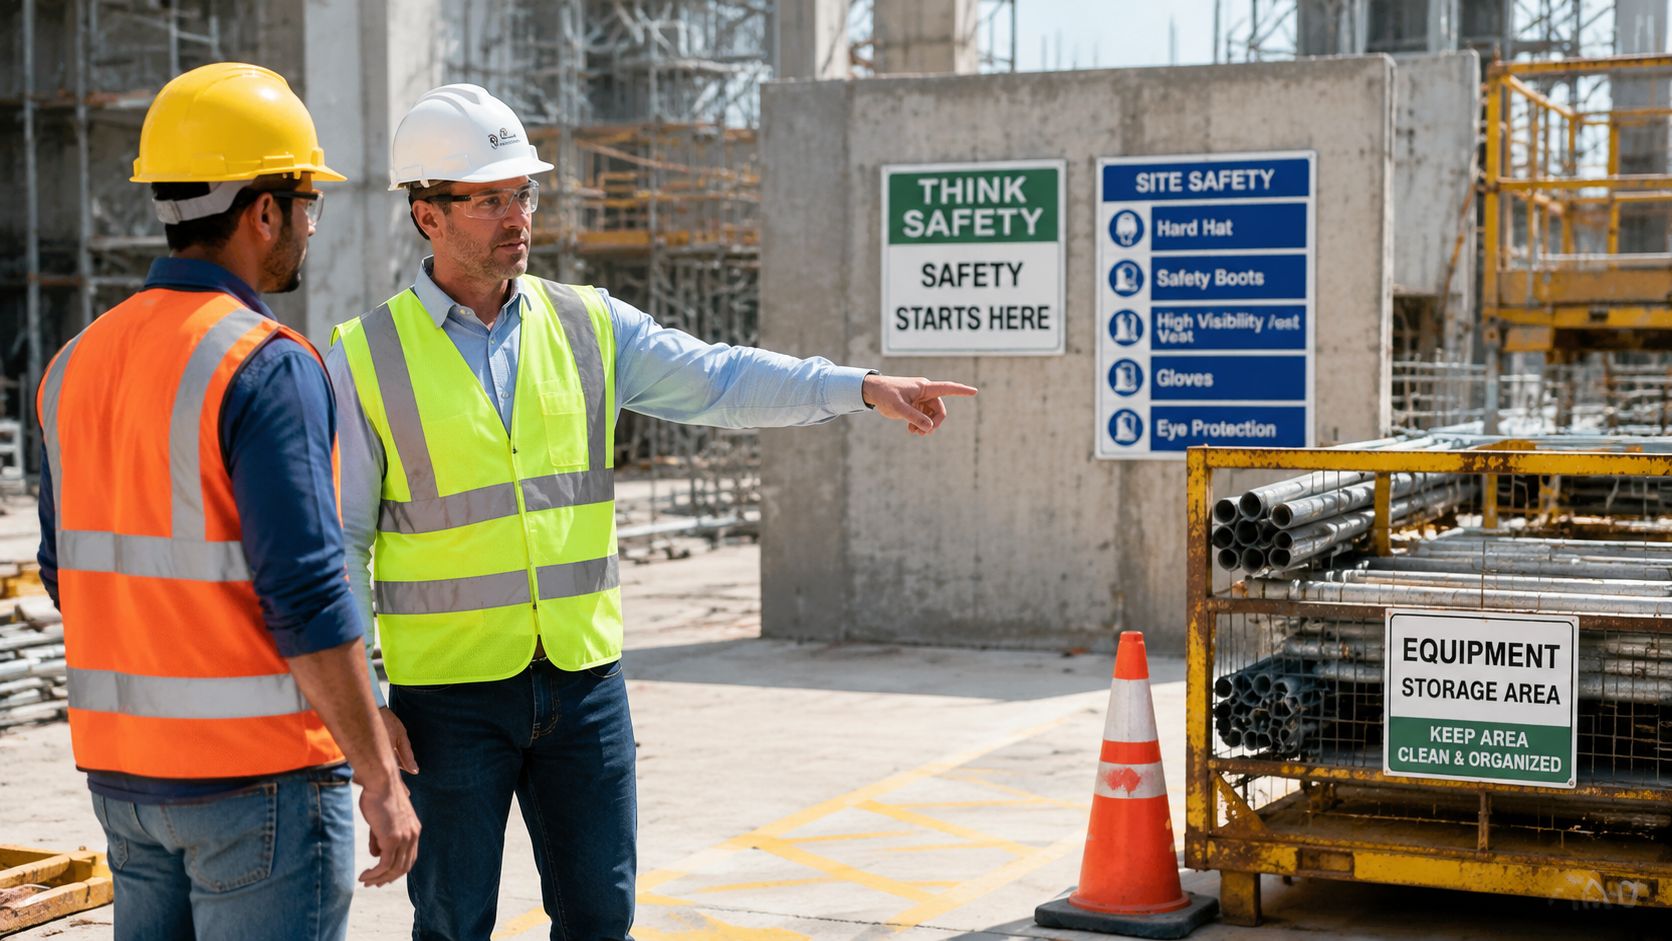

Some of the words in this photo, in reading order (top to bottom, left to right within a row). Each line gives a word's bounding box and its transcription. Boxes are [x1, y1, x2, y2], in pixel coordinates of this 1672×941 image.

[917, 175, 1027, 205] THINK
[1136, 171, 1183, 193] SITE
[1189, 169, 1275, 192] SAFETY
[902, 207, 1043, 237] SAFETY
[1157, 219, 1198, 237] Hard
[1203, 219, 1233, 236] Hat
[921, 262, 1023, 287] SAFETY
[1157, 269, 1210, 290] Safety
[1215, 269, 1265, 286] Boots
[896, 306, 981, 330] STARTS
[989, 306, 1050, 330] HERE
[1157, 313, 1194, 331] High
[1198, 313, 1264, 333] Visibility
[1157, 369, 1214, 387] Gloves
[1157, 420, 1188, 441] Eye
[1192, 420, 1277, 437] Protection
[1403, 637, 1561, 669] EQUIPMENT
[1402, 677, 1498, 702] STORAGE
[1504, 682, 1561, 705] AREA
[1430, 726, 1476, 745] KEEP
[1480, 730, 1529, 748] AREA
[1398, 746, 1449, 765] CLEAN
[1454, 750, 1465, 767] &
[1468, 751, 1562, 773] ORGANIZED
